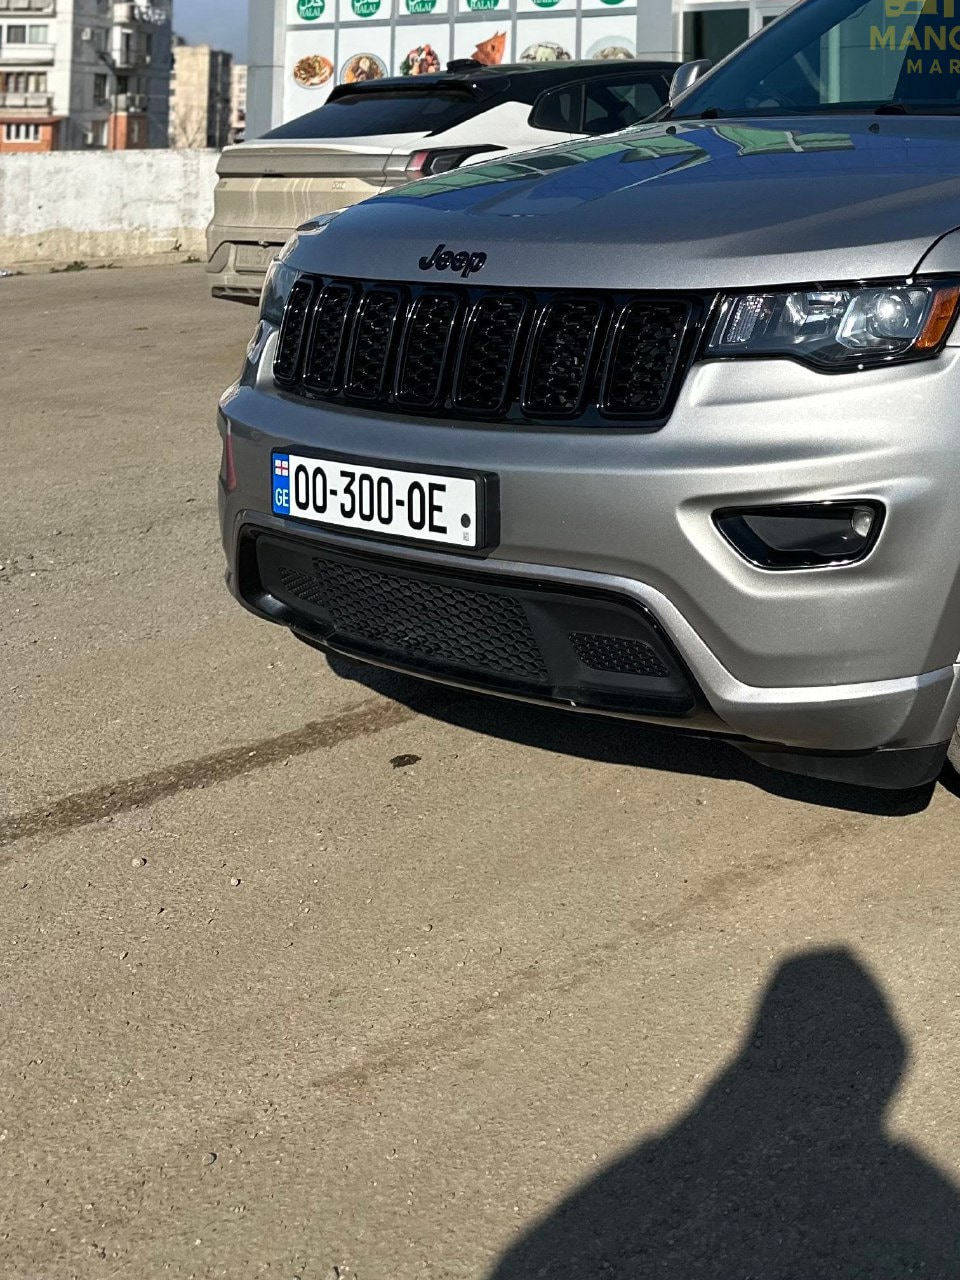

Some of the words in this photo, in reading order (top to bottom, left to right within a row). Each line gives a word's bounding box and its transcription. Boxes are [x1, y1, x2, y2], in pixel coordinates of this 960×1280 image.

[354, 4, 378, 14] HALAL
[409, 1, 433, 13] HALAL
[470, 0, 496, 10] HALAL
[300, 7, 321, 18] HALAL
[418, 244, 488, 278] Jeep
[275, 488, 289, 507] GE
